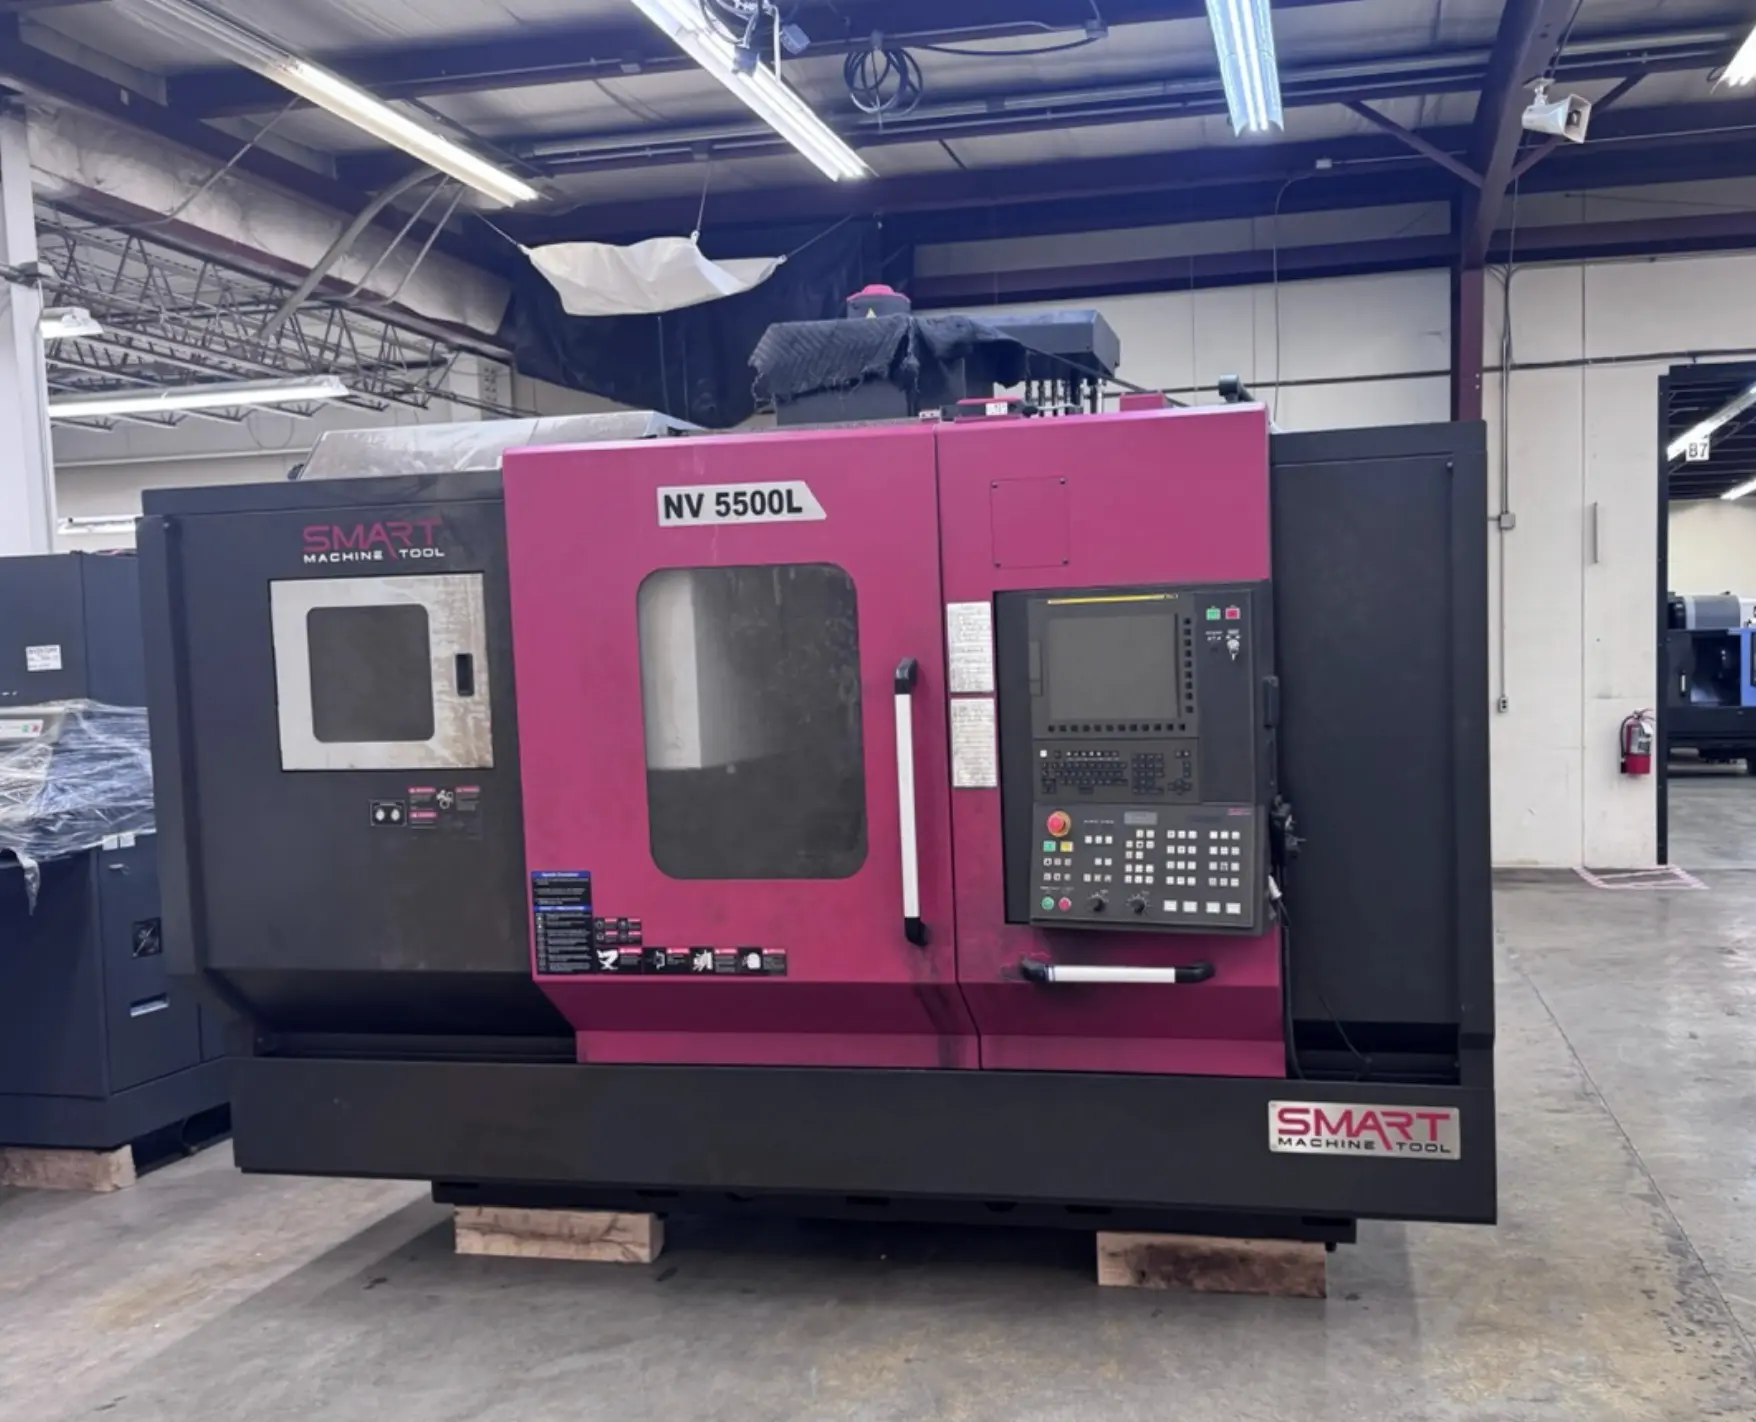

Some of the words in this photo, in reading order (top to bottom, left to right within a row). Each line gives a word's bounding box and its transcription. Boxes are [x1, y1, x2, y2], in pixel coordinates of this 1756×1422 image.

[663, 493, 704, 519] NV
[715, 489, 803, 517] 5500L
[303, 517, 442, 561] SMART
[303, 550, 383, 564] MACHINE
[399, 548, 445, 558] TOOL
[1277, 1107, 1451, 1151] SMART
[1278, 1137, 1375, 1150] MACHINE
[1396, 1142, 1452, 1154] TOOL
